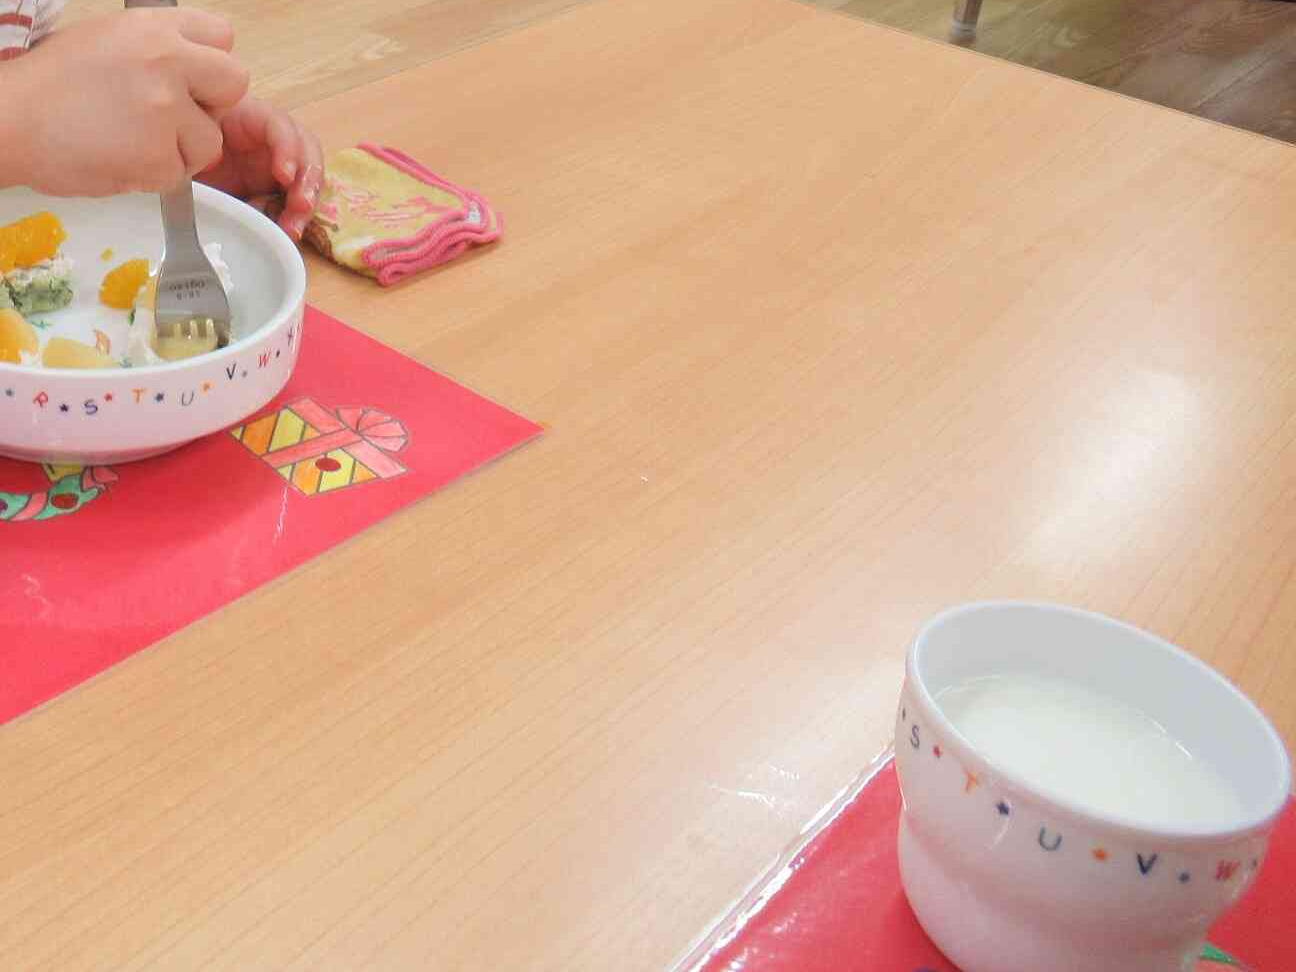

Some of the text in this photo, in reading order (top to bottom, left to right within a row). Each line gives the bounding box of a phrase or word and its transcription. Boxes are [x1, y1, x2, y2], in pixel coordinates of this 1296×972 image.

[33, 391, 49, 408] R
[84, 399, 98, 416] S
[131, 389, 145, 404] T
[180, 390, 195, 407] U
[226, 364, 237, 380] V
[258, 351, 272, 368] W
[910, 724, 920, 749] S
[1038, 826, 1062, 851] U
[1135, 852, 1158, 876] V
[1215, 860, 1241, 882] W
